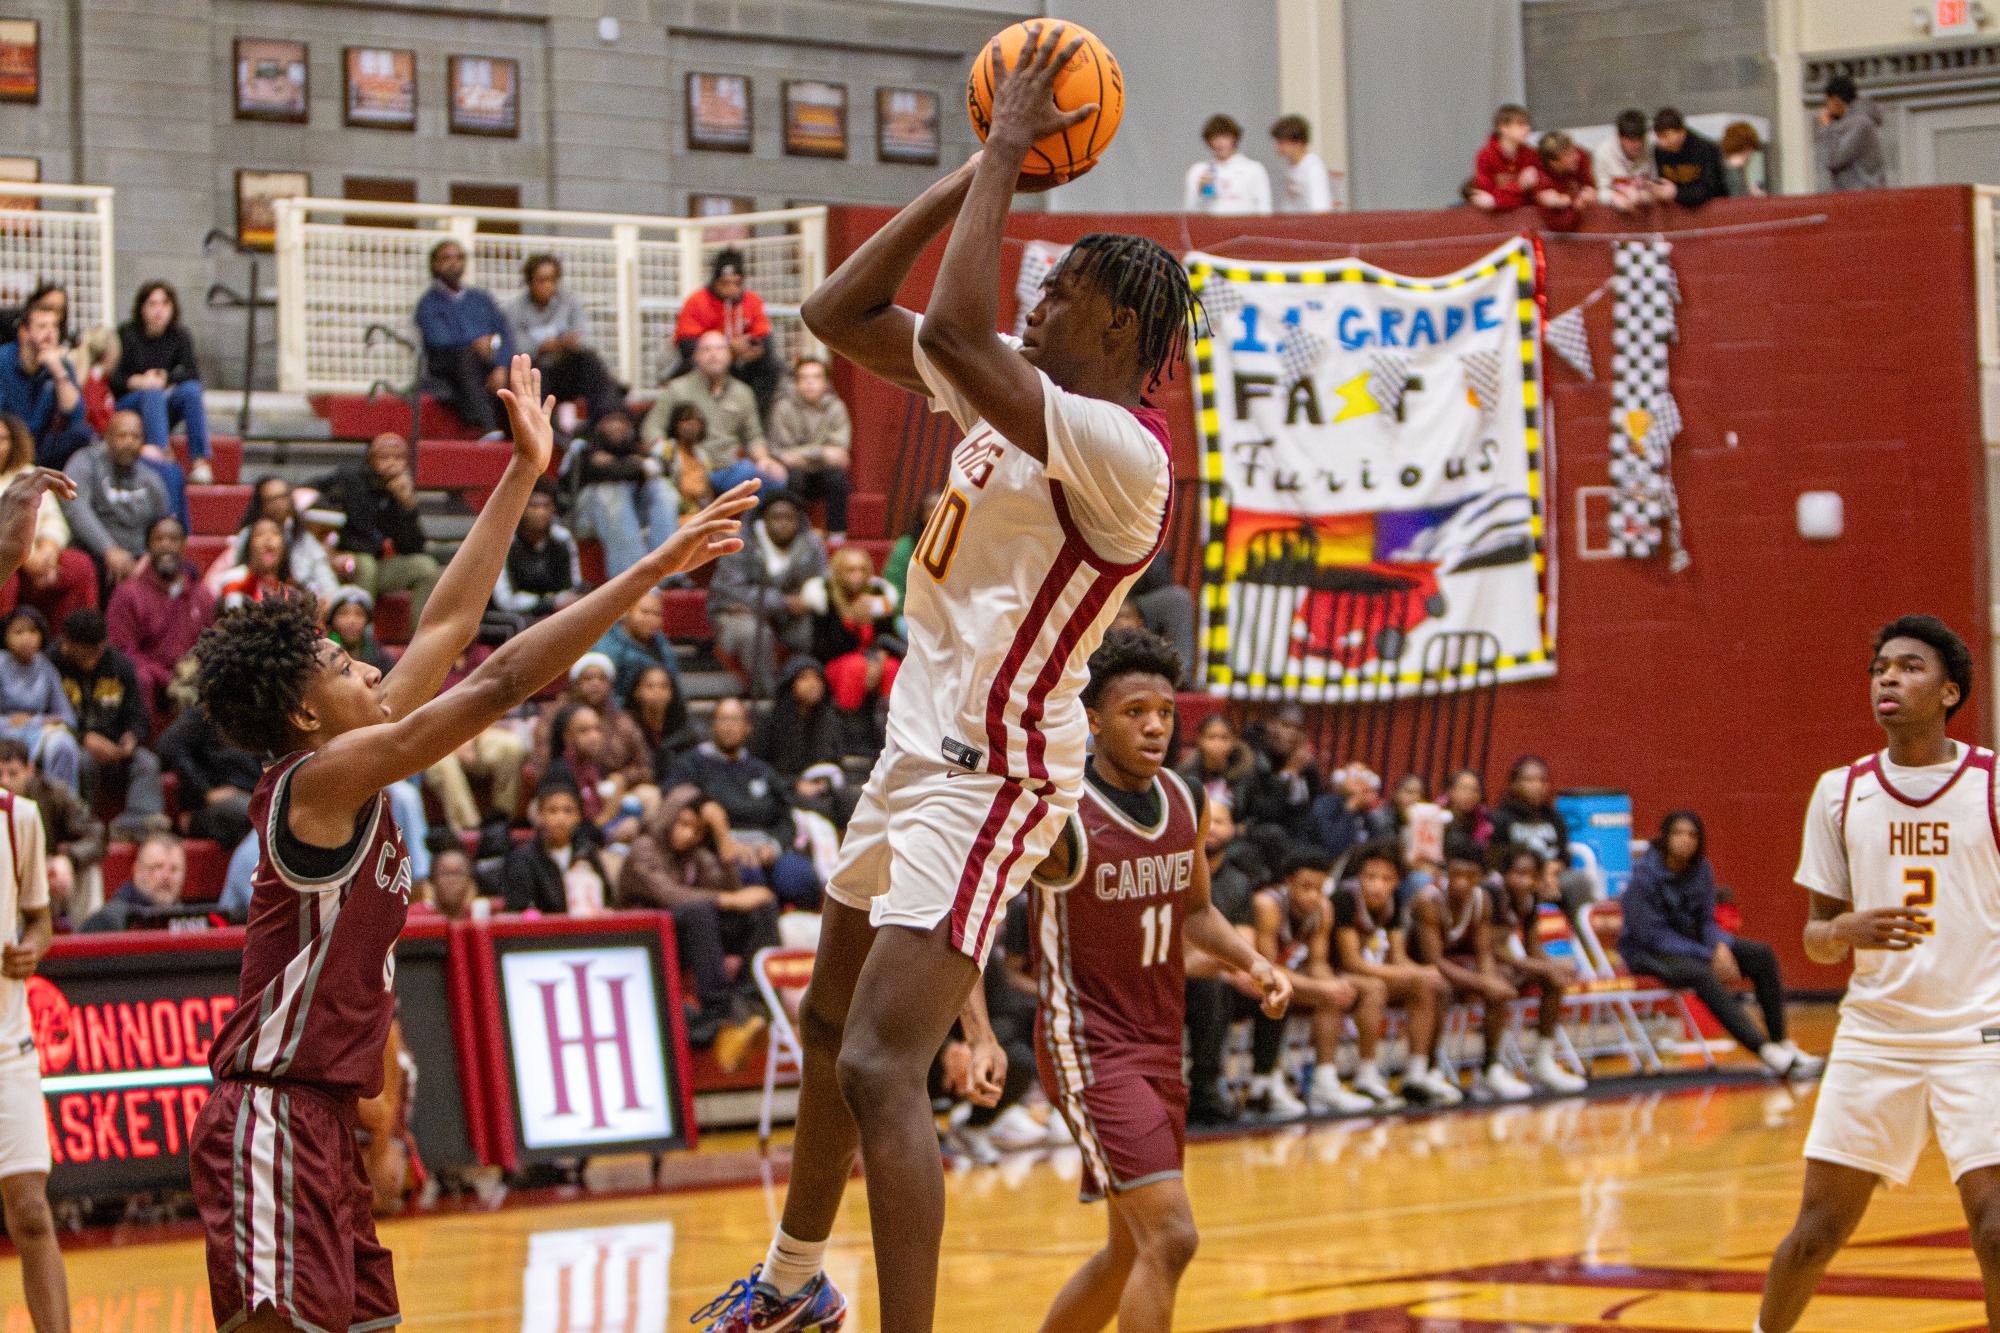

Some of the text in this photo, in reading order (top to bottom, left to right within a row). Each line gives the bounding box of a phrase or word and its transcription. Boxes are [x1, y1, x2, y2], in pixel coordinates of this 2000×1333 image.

[1337, 297, 1503, 351] GRADE
[1889, 821, 1950, 856] HIES
[1096, 849, 1194, 901] CARVE
[1903, 867, 1937, 936] 2
[1141, 903, 1173, 968] 11
